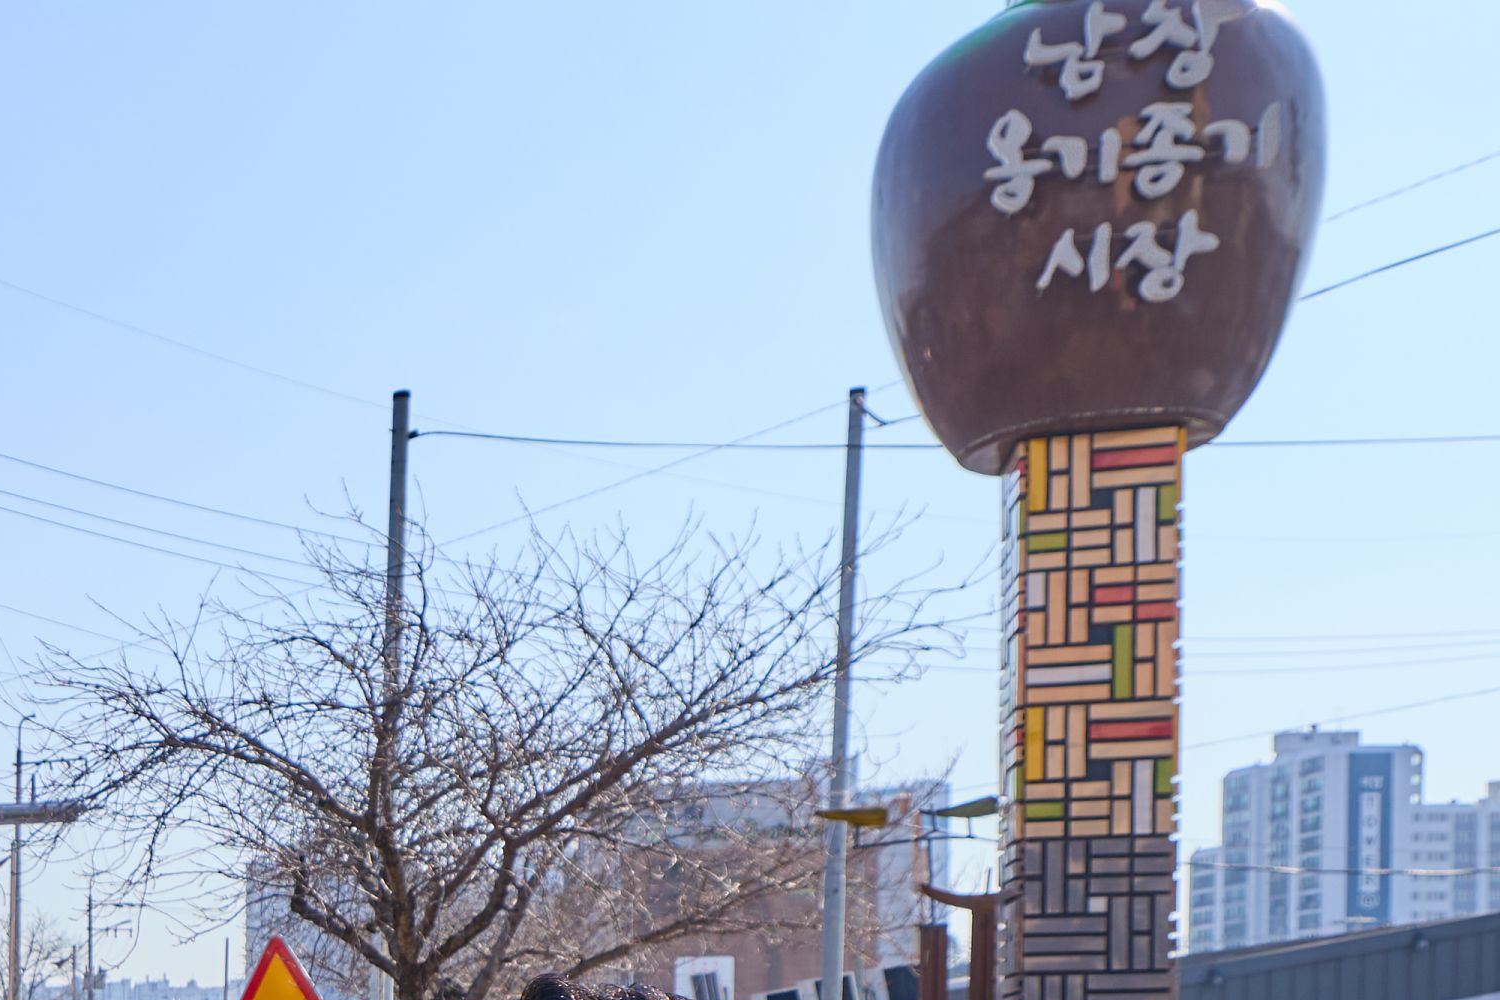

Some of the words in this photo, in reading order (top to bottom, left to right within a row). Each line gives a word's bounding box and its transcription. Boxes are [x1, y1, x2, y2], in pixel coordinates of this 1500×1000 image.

[1024, 0, 1246, 100] 남창
[984, 102, 1281, 214] 옹기종기
[1036, 208, 1220, 302] 시장
